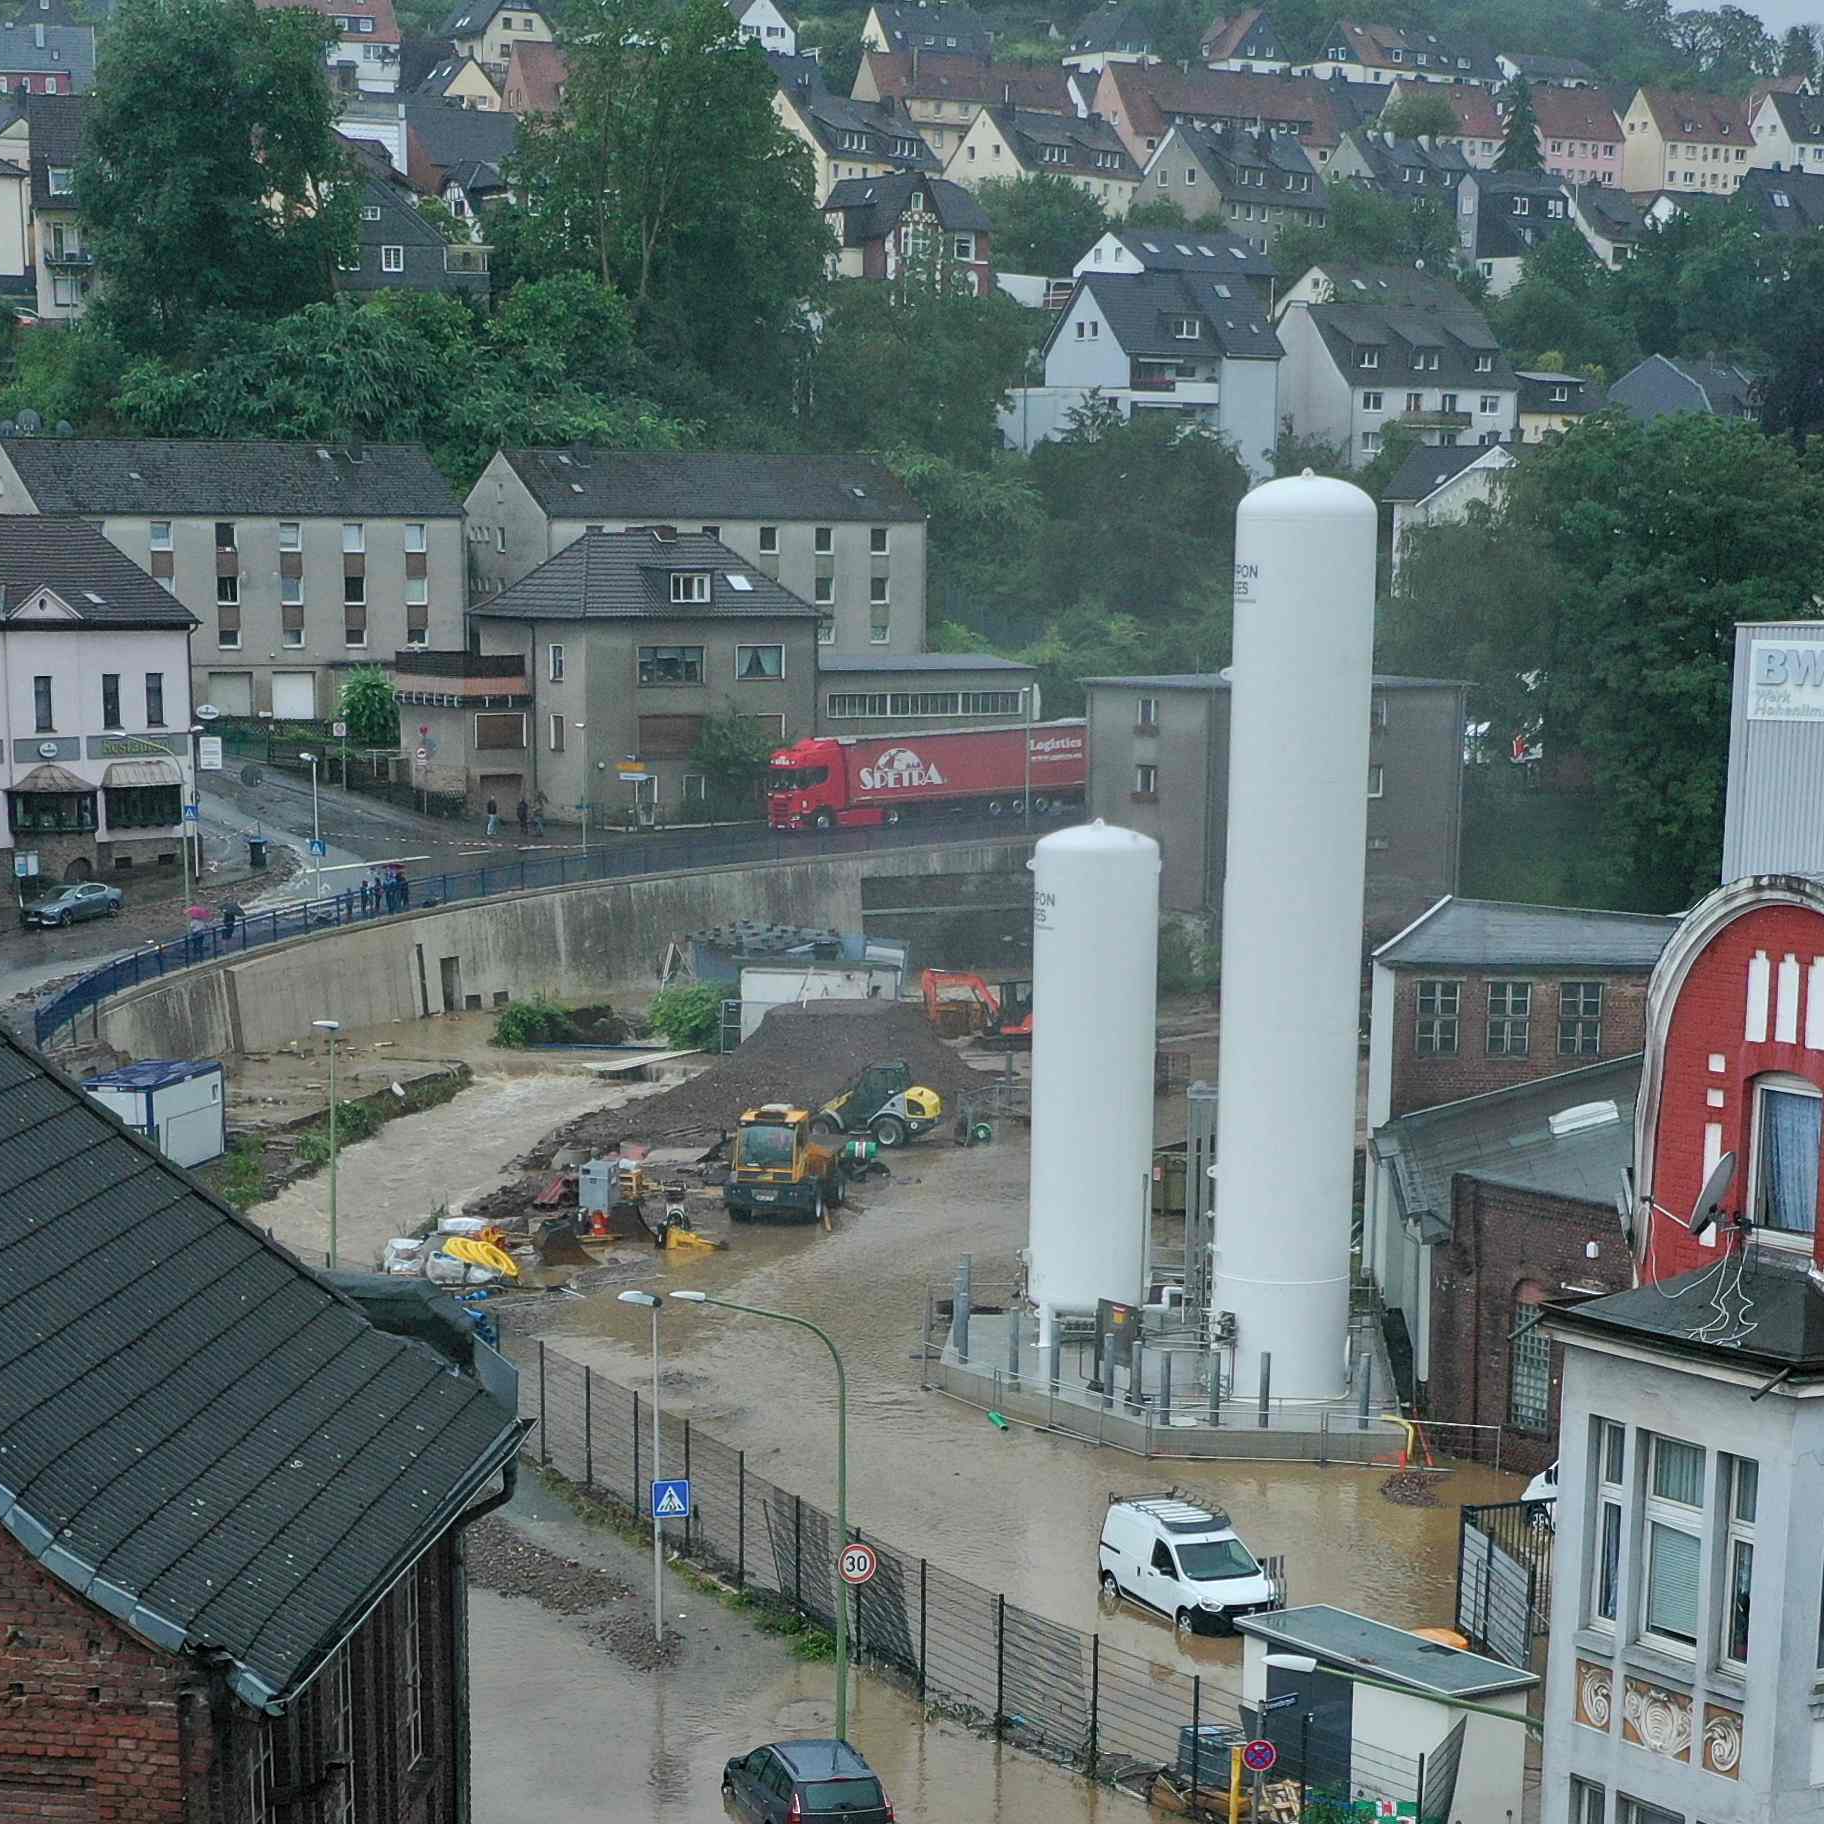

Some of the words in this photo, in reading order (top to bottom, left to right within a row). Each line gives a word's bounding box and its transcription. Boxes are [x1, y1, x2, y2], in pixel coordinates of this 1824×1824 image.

[1030, 738, 1082, 751] Logistics
[859, 762, 945, 790] SPETRA
[846, 1555, 867, 1572] 30
